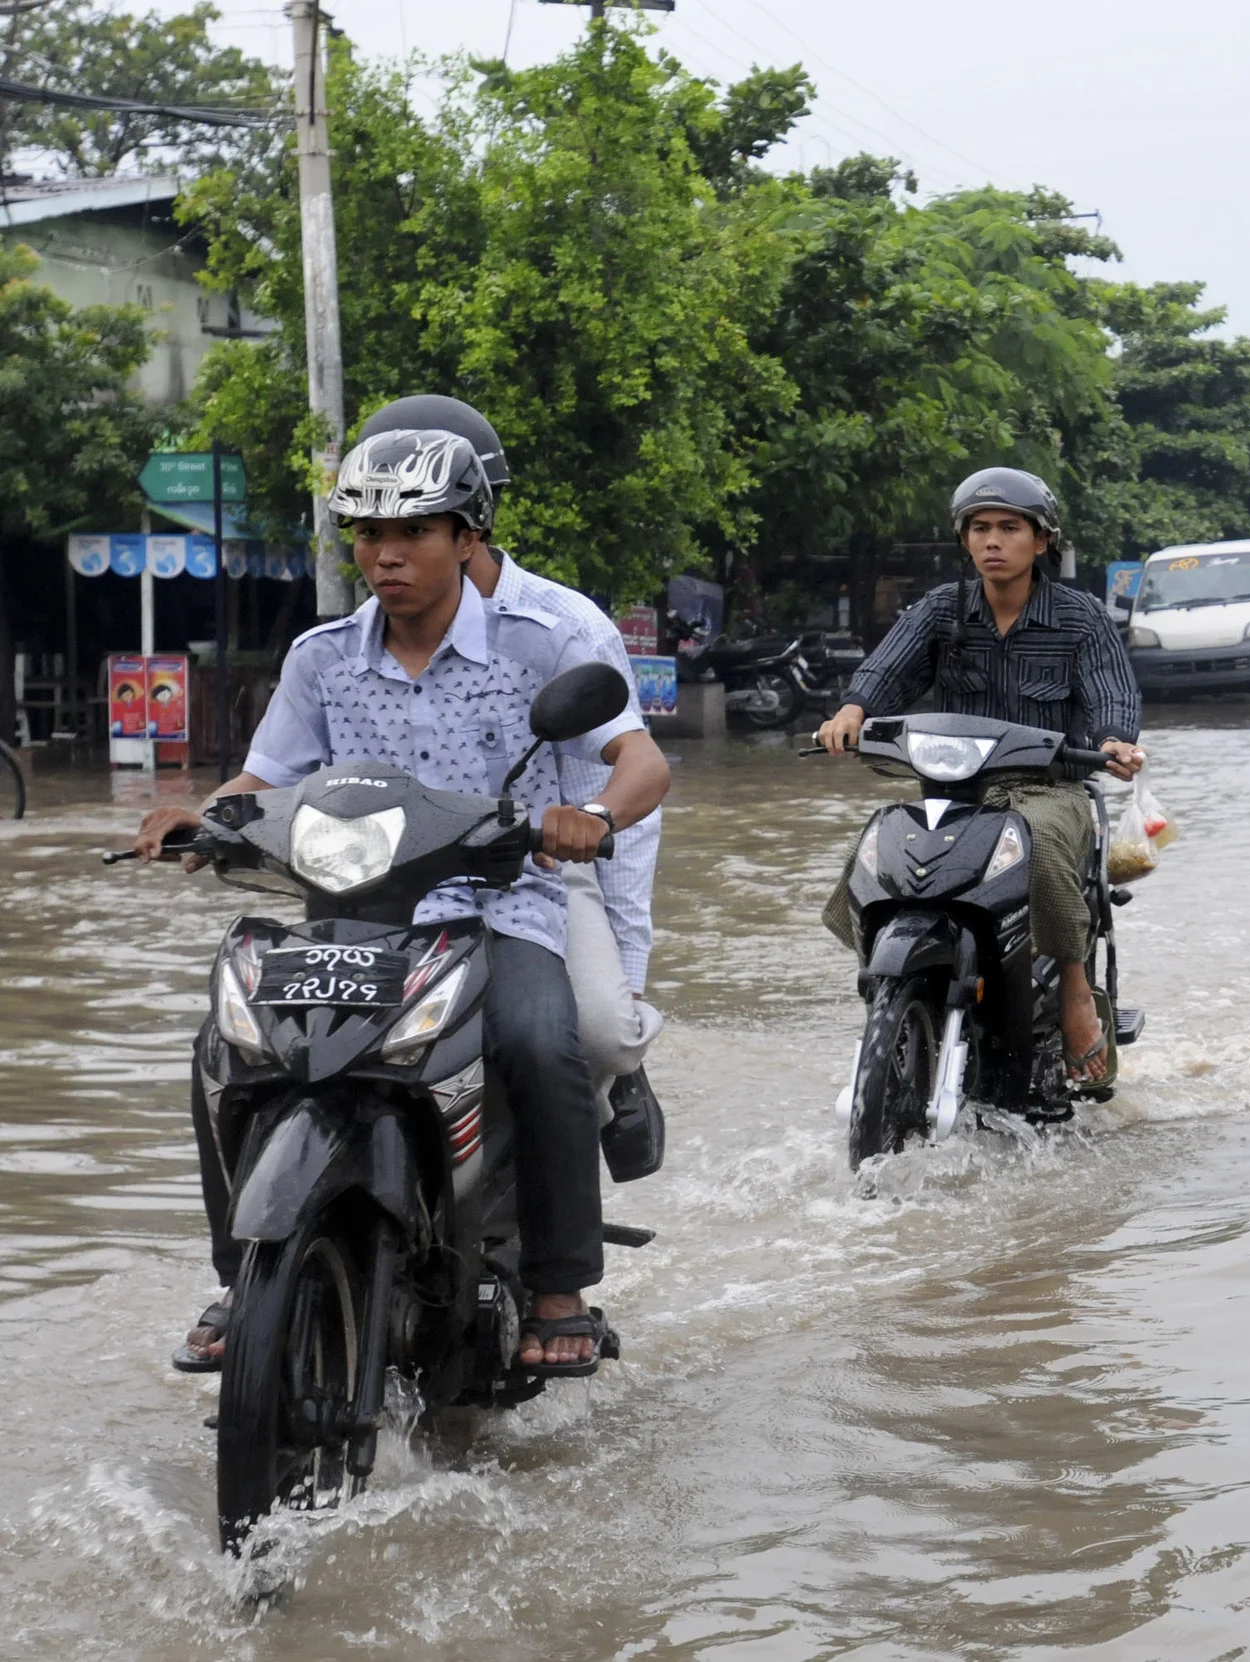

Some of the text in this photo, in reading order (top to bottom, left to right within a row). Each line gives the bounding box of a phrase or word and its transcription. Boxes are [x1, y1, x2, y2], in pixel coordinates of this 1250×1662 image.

[178, 461, 205, 472] Street
[305, 949, 375, 971] ၁၇ယ
[283, 977, 377, 1001] ၇၃၂၇၄
